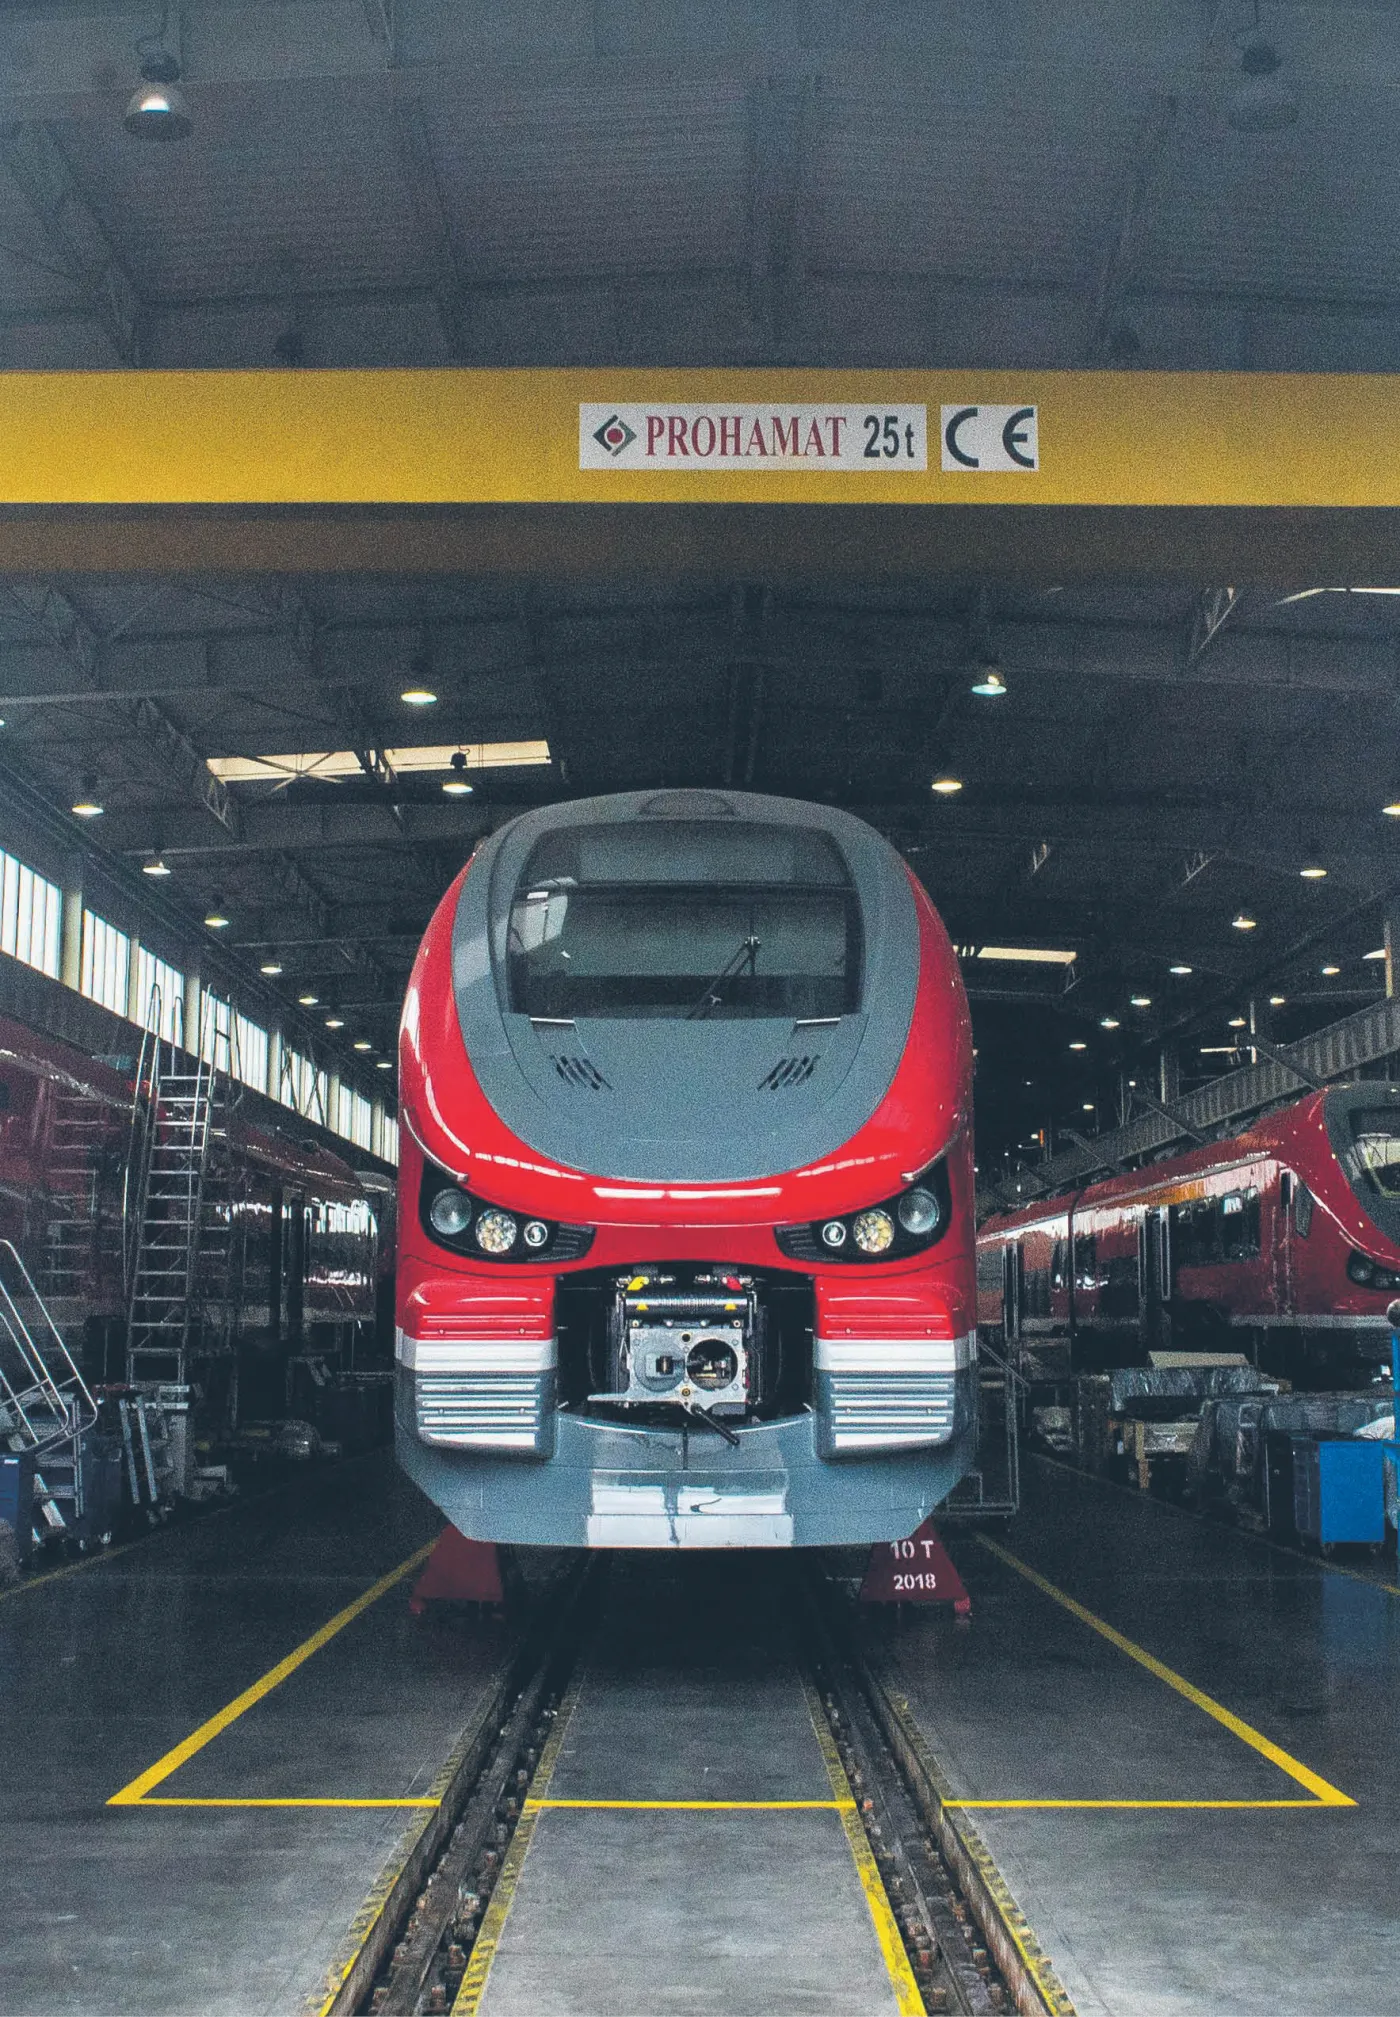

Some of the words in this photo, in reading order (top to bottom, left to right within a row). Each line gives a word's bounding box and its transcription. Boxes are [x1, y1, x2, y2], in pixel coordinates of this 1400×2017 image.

[646, 414, 847, 457] PROHAMAT
[945, 407, 1036, 468] CE
[890, 1540, 915, 1559] 10
[920, 1540, 934, 1559] T
[893, 1573, 937, 1590] 2018
